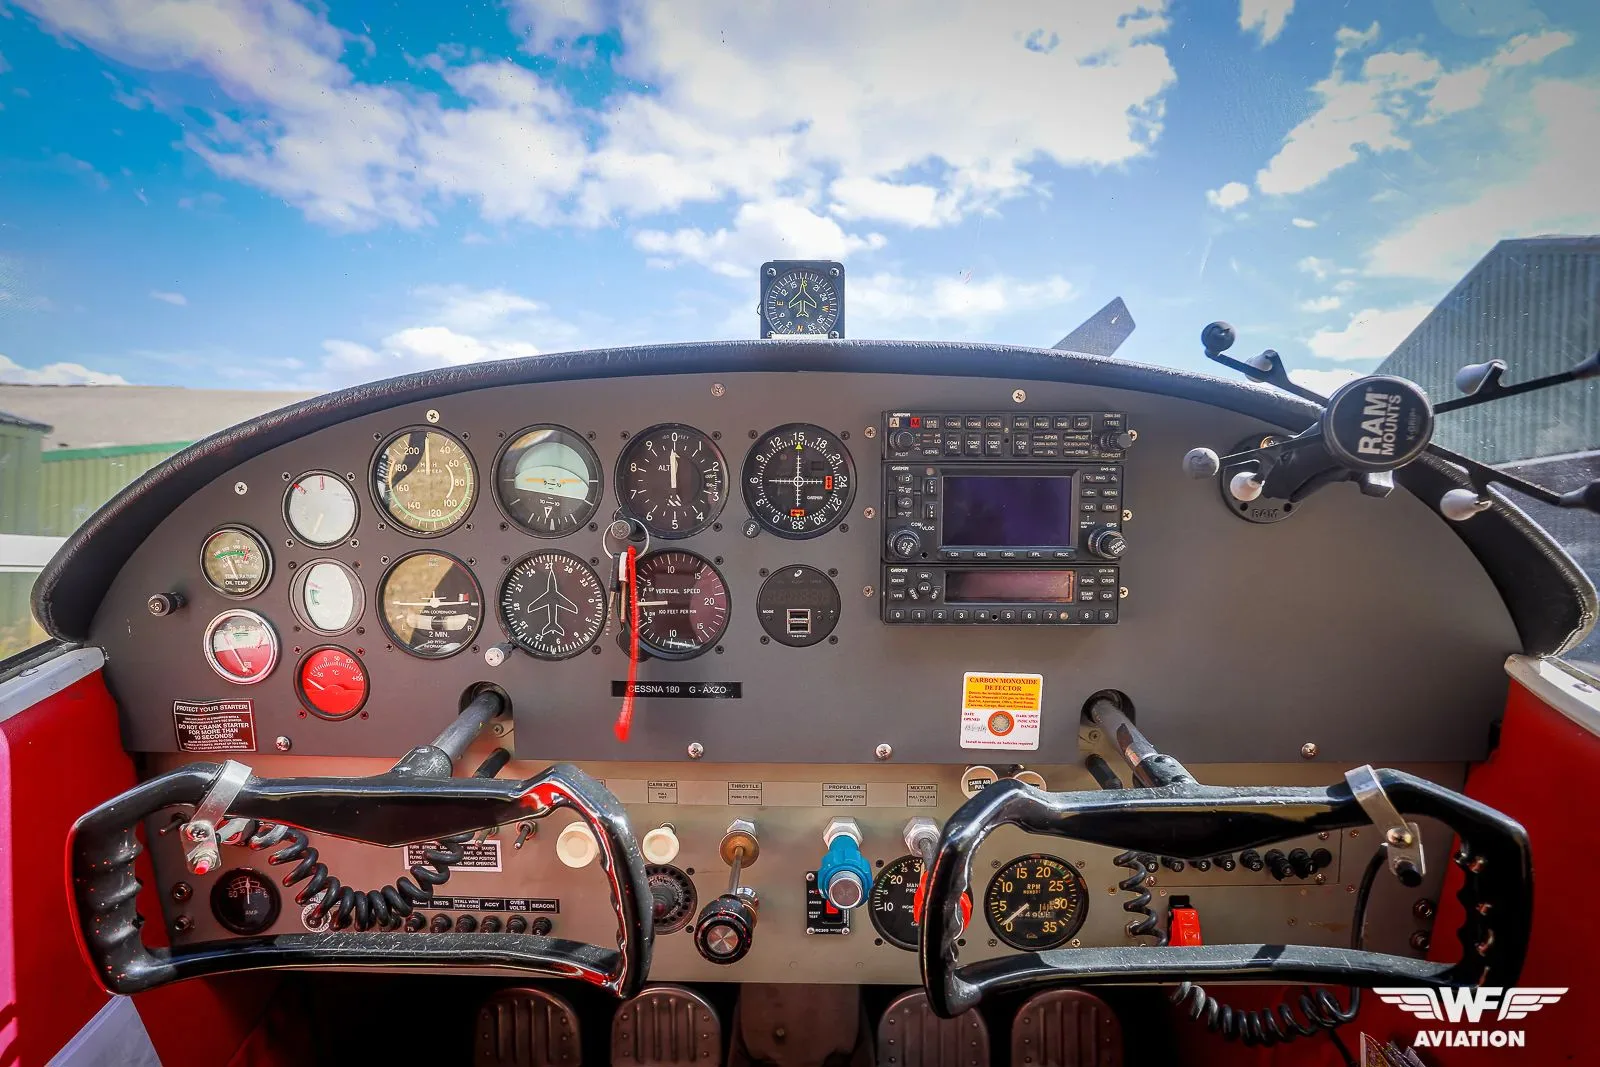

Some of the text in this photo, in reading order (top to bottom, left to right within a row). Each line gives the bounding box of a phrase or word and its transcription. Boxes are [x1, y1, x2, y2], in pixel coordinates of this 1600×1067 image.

[1357, 392, 1390, 455] RAM
[1381, 394, 1402, 456] MOUNTS
[671, 432, 679, 442] 0
[793, 432, 805, 441] 15
[645, 440, 653, 451] 9
[698, 440, 702, 451] 1
[769, 437, 782, 448] 12
[816, 437, 828, 449] 18
[405, 446, 420, 455] 200
[440, 446, 451, 455] 40
[755, 454, 765, 463] 9
[831, 453, 843, 466] 21
[395, 463, 408, 472] 180
[449, 460, 459, 468] 60
[630, 462, 637, 472] 8
[657, 464, 671, 472] ALT
[712, 461, 720, 471] 2
[455, 479, 465, 487] 80
[839, 475, 848, 488] 24
[396, 484, 409, 492] 160
[630, 489, 638, 500] 7
[712, 492, 720, 502] 3
[407, 501, 421, 510] 140
[443, 499, 457, 508] 100
[755, 499, 765, 507] 3
[832, 497, 842, 511] 27
[428, 509, 442, 518] 120
[646, 512, 653, 521] 6
[696, 512, 704, 522] 4
[1252, 508, 1280, 518] RAM
[772, 514, 780, 524] 0
[813, 513, 826, 525] 30
[671, 520, 679, 529] 5
[746, 523, 756, 536] OBS
[792, 521, 805, 530] 33
[1110, 540, 1124, 551] PUSH
[526, 569, 536, 578] 24
[563, 565, 573, 574] 30
[667, 565, 675, 574] 10
[694, 572, 701, 580] 15
[579, 577, 589, 587] 33
[515, 583, 524, 593] 21
[513, 602, 521, 611] 18
[704, 597, 715, 606] 20
[467, 624, 473, 632] R
[519, 620, 529, 629] 15
[696, 622, 704, 630] 15
[535, 633, 544, 642] 12
[669, 629, 677, 638] 10
[628, 685, 727, 694] CESSNA 180 G AXZO
[176, 704, 198, 712] PROTECT
[1226, 861, 1231, 869] 5
[1016, 867, 1028, 879] 15
[1035, 866, 1051, 878] 20
[890, 874, 903, 885] 20
[1002, 881, 1013, 893] 10
[1048, 880, 1064, 892] 25
[884, 902, 894, 912] 10
[999, 900, 1007, 911] 5
[1053, 898, 1068, 910] 30
[1005, 922, 1013, 932] 0
[1042, 921, 1057, 933] 35
